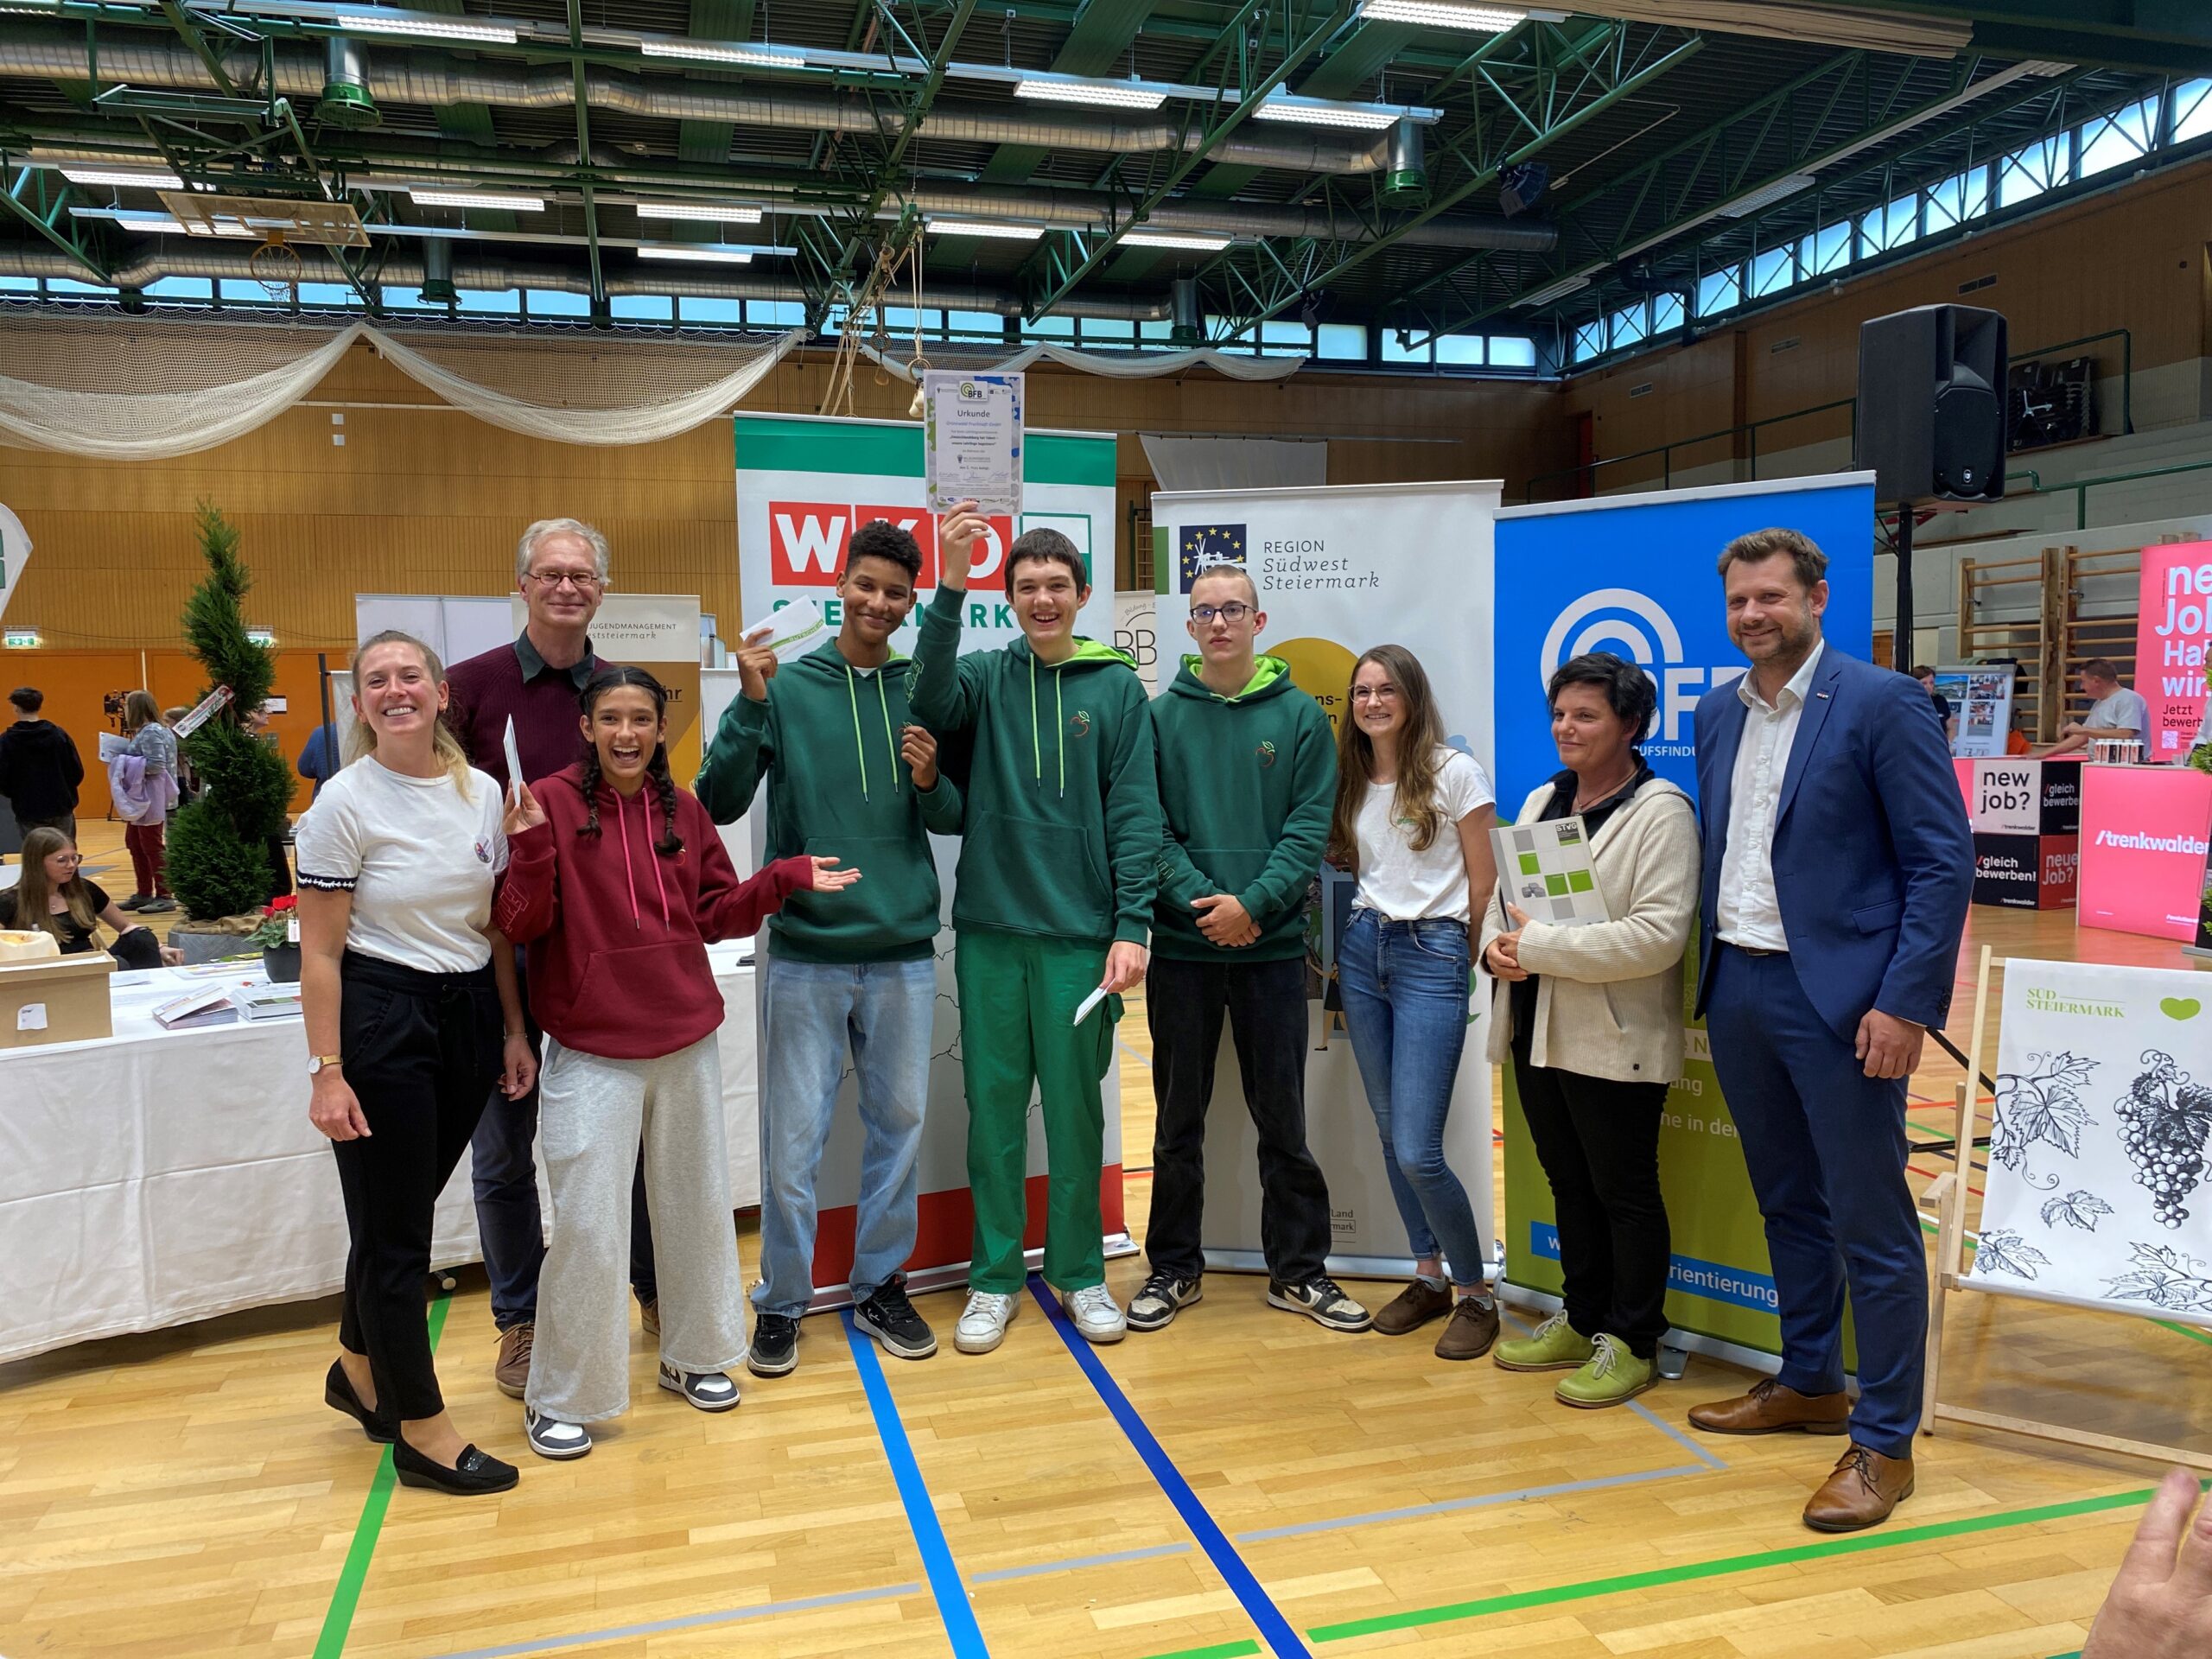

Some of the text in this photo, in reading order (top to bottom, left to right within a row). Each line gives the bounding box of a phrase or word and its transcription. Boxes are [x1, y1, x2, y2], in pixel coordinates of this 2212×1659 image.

[774, 513, 1003, 579] WO
[1264, 540, 1325, 554] REGION
[1262, 556, 1349, 573] Südwest
[1262, 571, 1380, 590] Steiermark
[2167, 563, 2212, 596] ne
[2163, 639, 2209, 667] Ha
[2163, 704, 2193, 715] Jetzt
[1631, 745, 1696, 757] UFSFIND
[1983, 771, 2031, 787] new
[1980, 790, 2031, 814] job?
[1975, 868, 2037, 882] bewerben!
[2025, 999, 2125, 1018] STEIERMARK
[1688, 1114, 1704, 1132] in
[1331, 1209, 1354, 1218] Land
